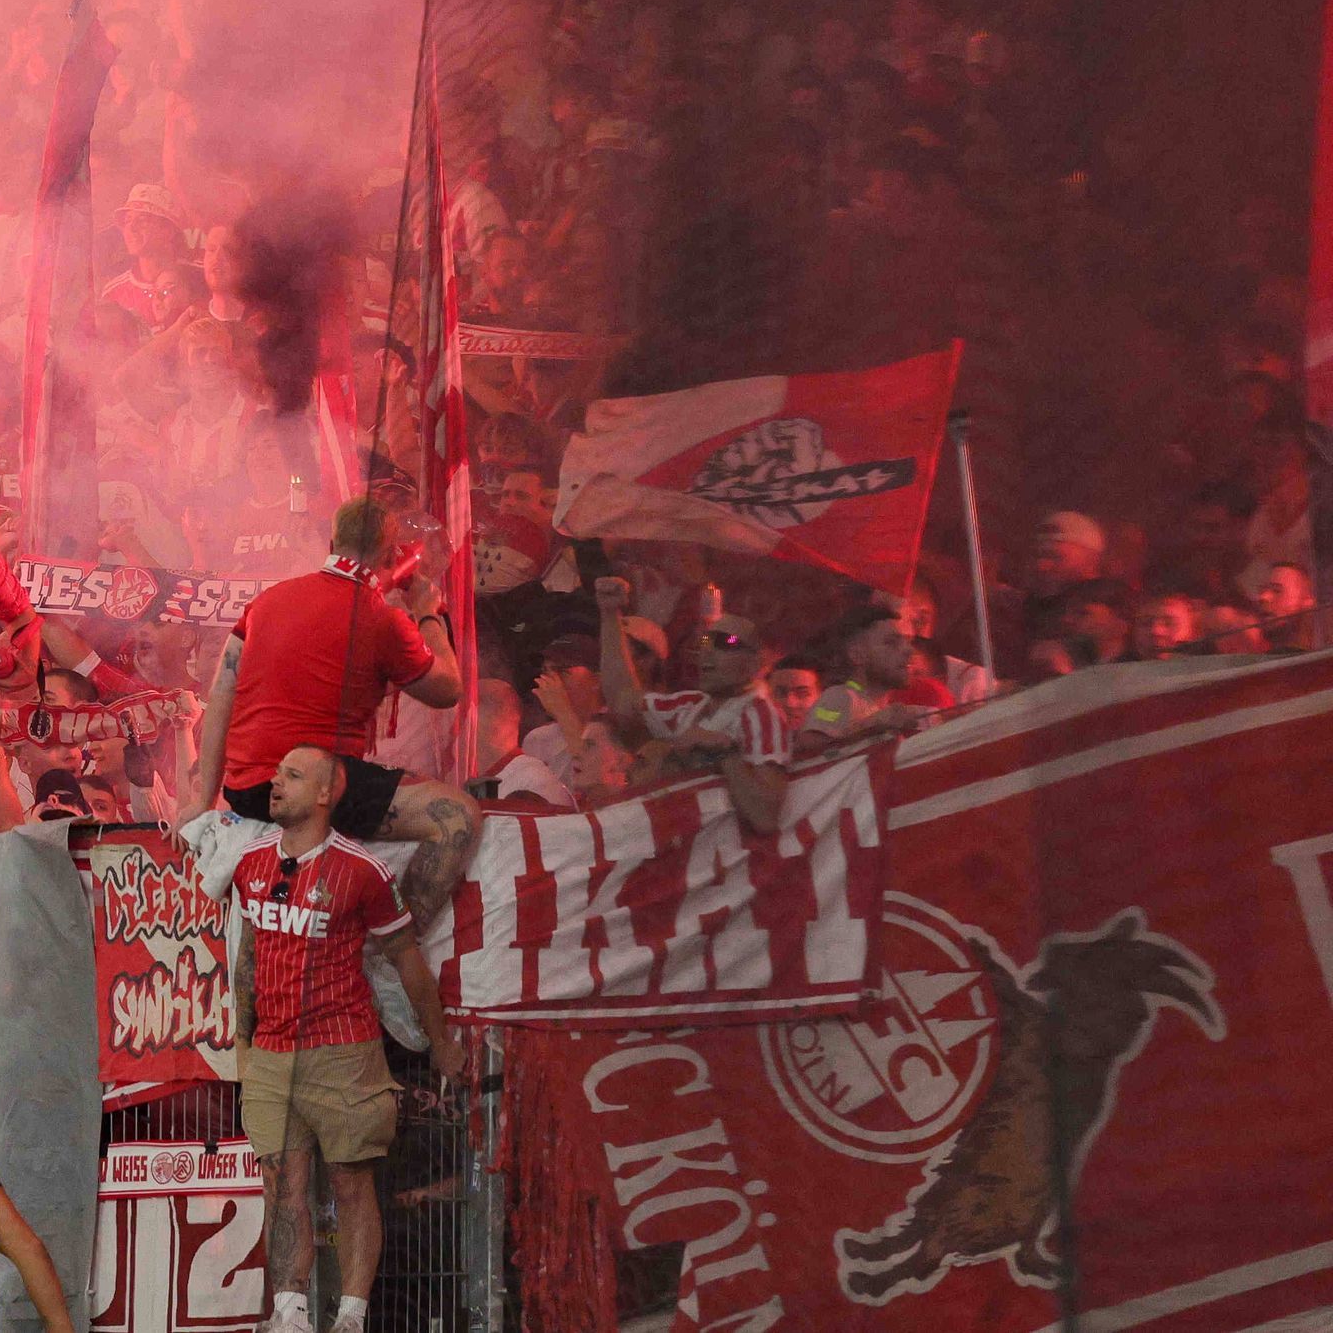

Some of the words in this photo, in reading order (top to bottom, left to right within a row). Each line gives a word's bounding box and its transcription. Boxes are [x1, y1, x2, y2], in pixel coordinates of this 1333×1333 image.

[247, 899, 331, 938] REWE
[113, 1155, 149, 1183] WEISS
[198, 1153, 238, 1180] UNSER
